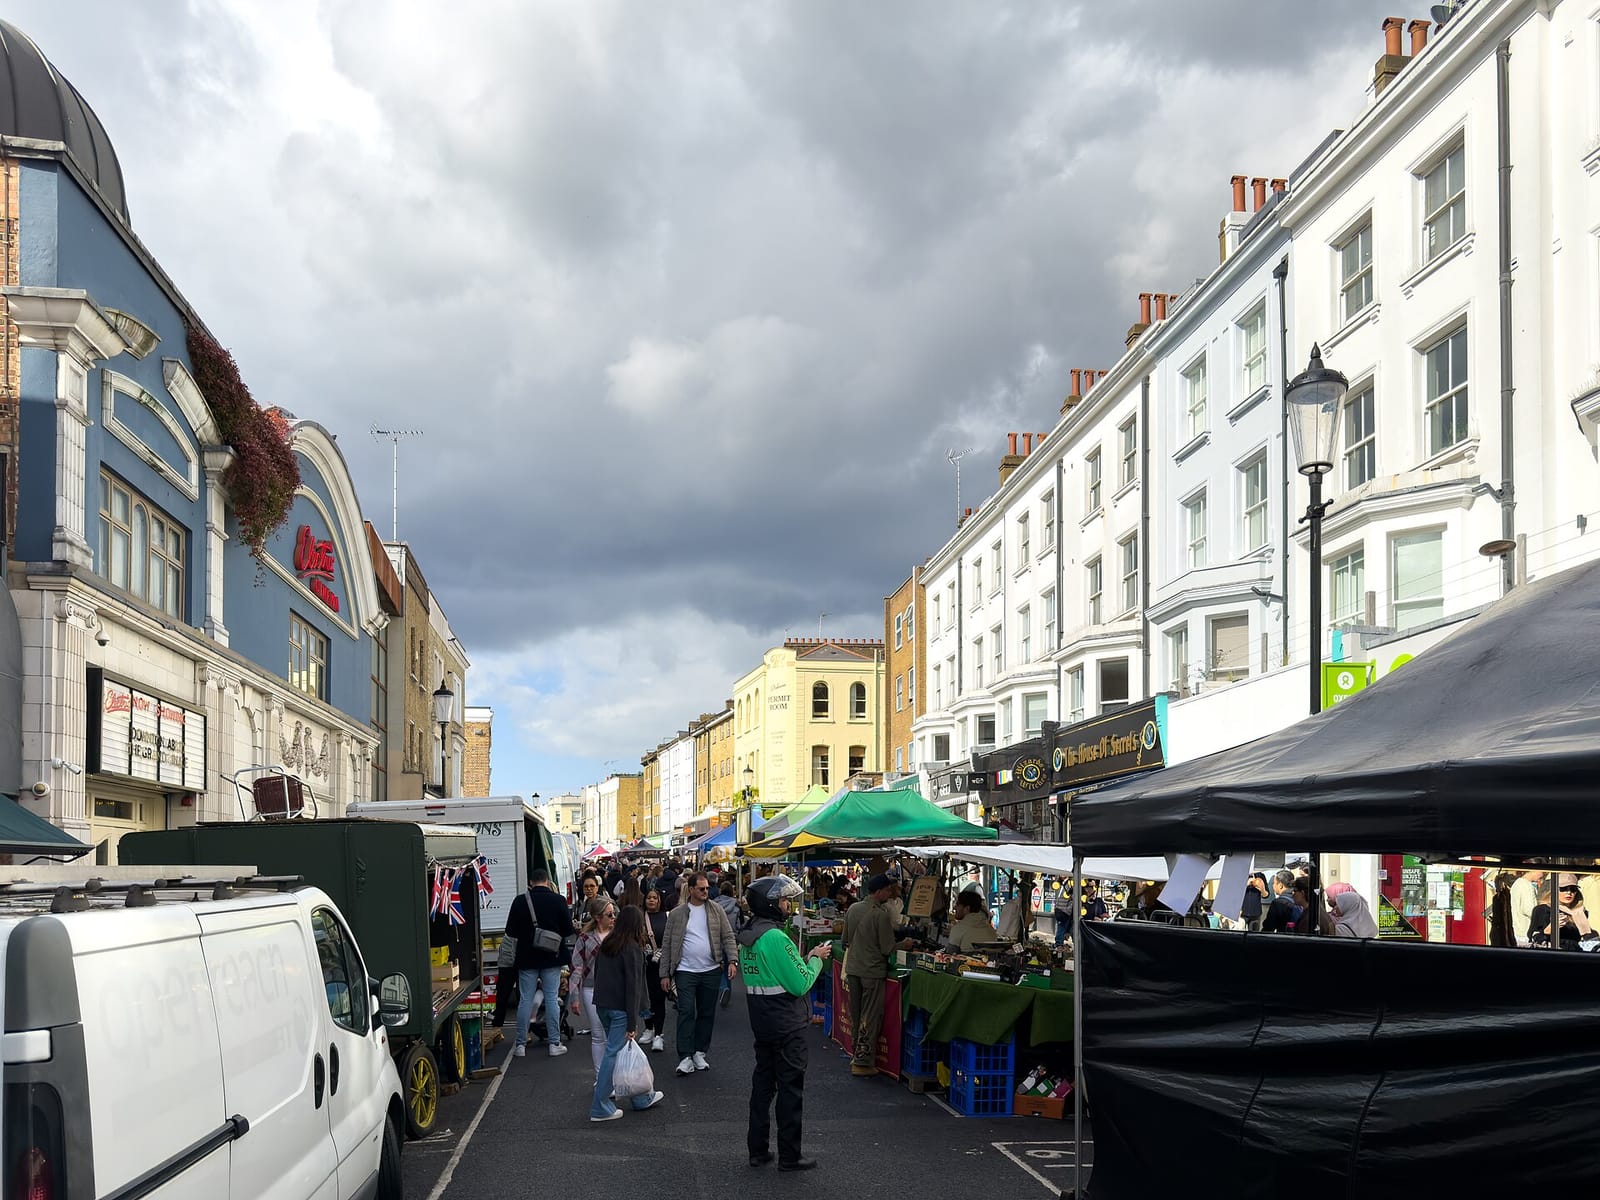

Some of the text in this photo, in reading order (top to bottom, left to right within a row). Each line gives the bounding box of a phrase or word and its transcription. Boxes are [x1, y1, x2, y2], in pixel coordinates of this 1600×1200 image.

[132, 697, 151, 712] NOW
[769, 703, 788, 711] ROOM
[1063, 730, 1138, 767] The House Of Secrets
[784, 944, 798, 963] Uber
